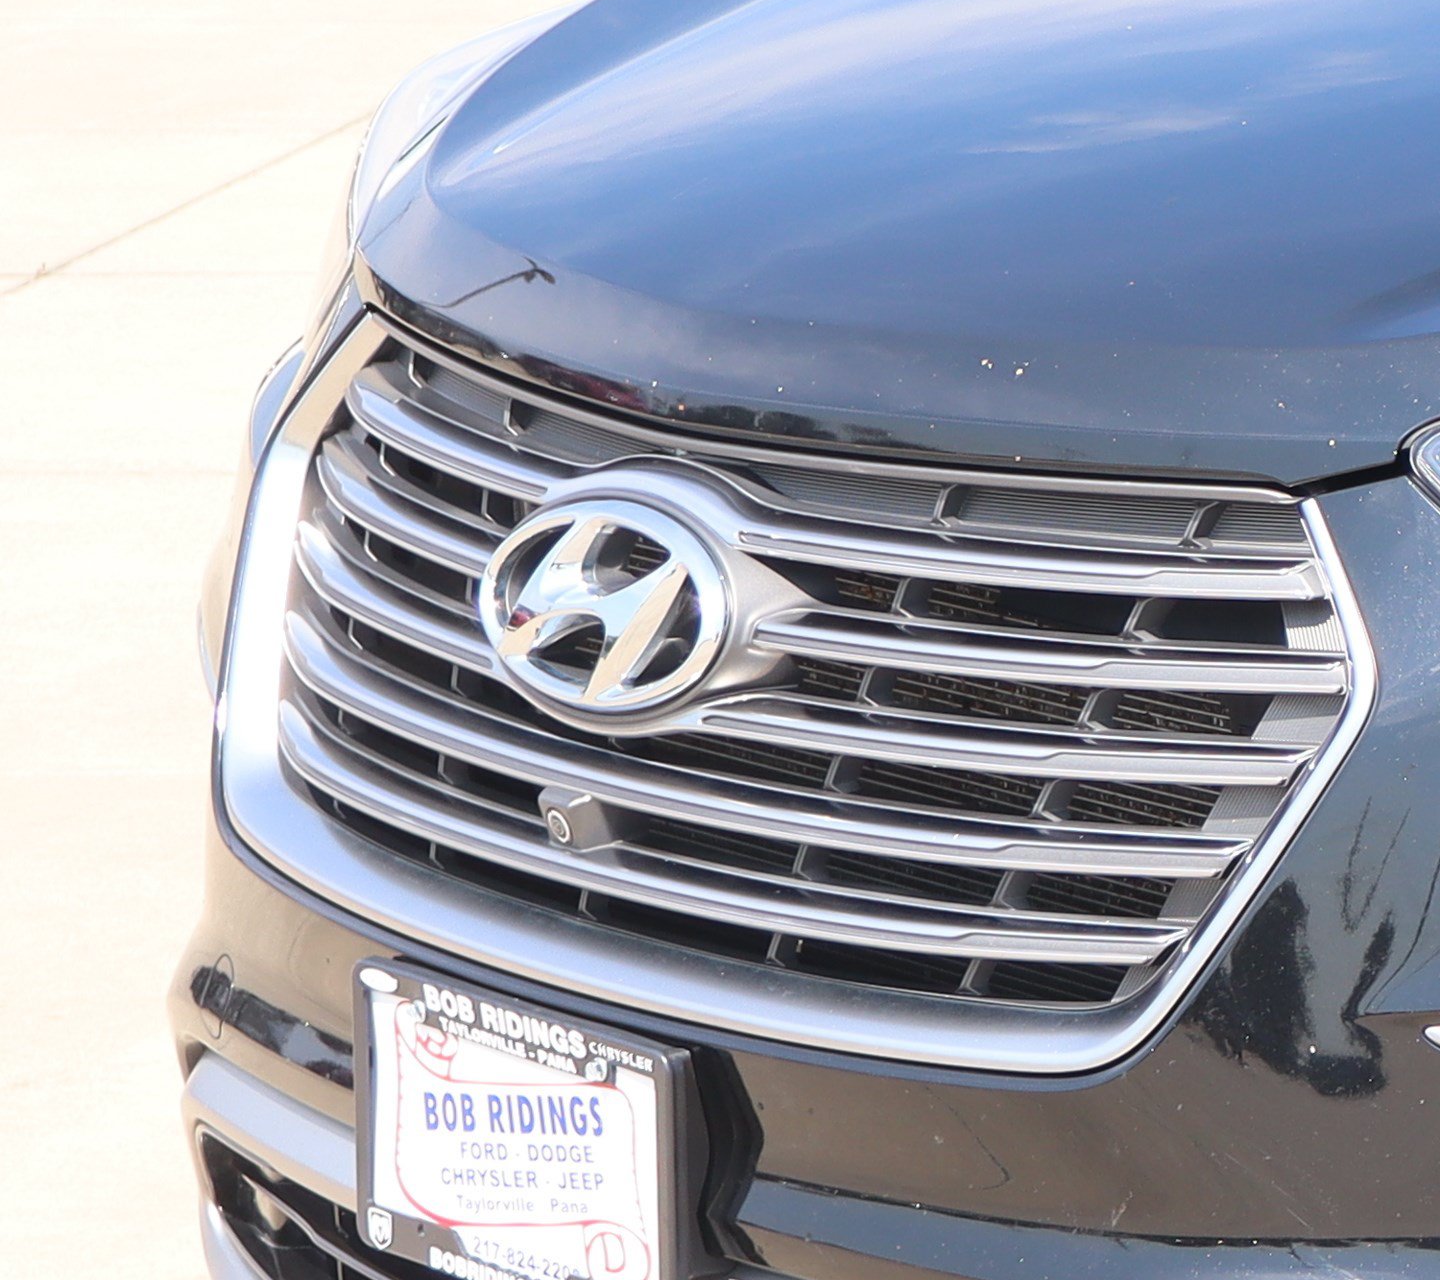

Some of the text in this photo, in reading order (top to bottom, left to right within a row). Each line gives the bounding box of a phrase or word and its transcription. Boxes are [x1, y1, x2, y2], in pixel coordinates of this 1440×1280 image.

[423, 983, 653, 1073] BOB RIDINGS CHRYSLER
[537, 1048, 577, 1074] PANA
[423, 1091, 604, 1137] BOB RIDINGS
[460, 1142, 595, 1164] FORD DODGE
[441, 1168, 604, 1191] CHRYSLER JEEP
[456, 1194, 589, 1215] Taylorville Pana
